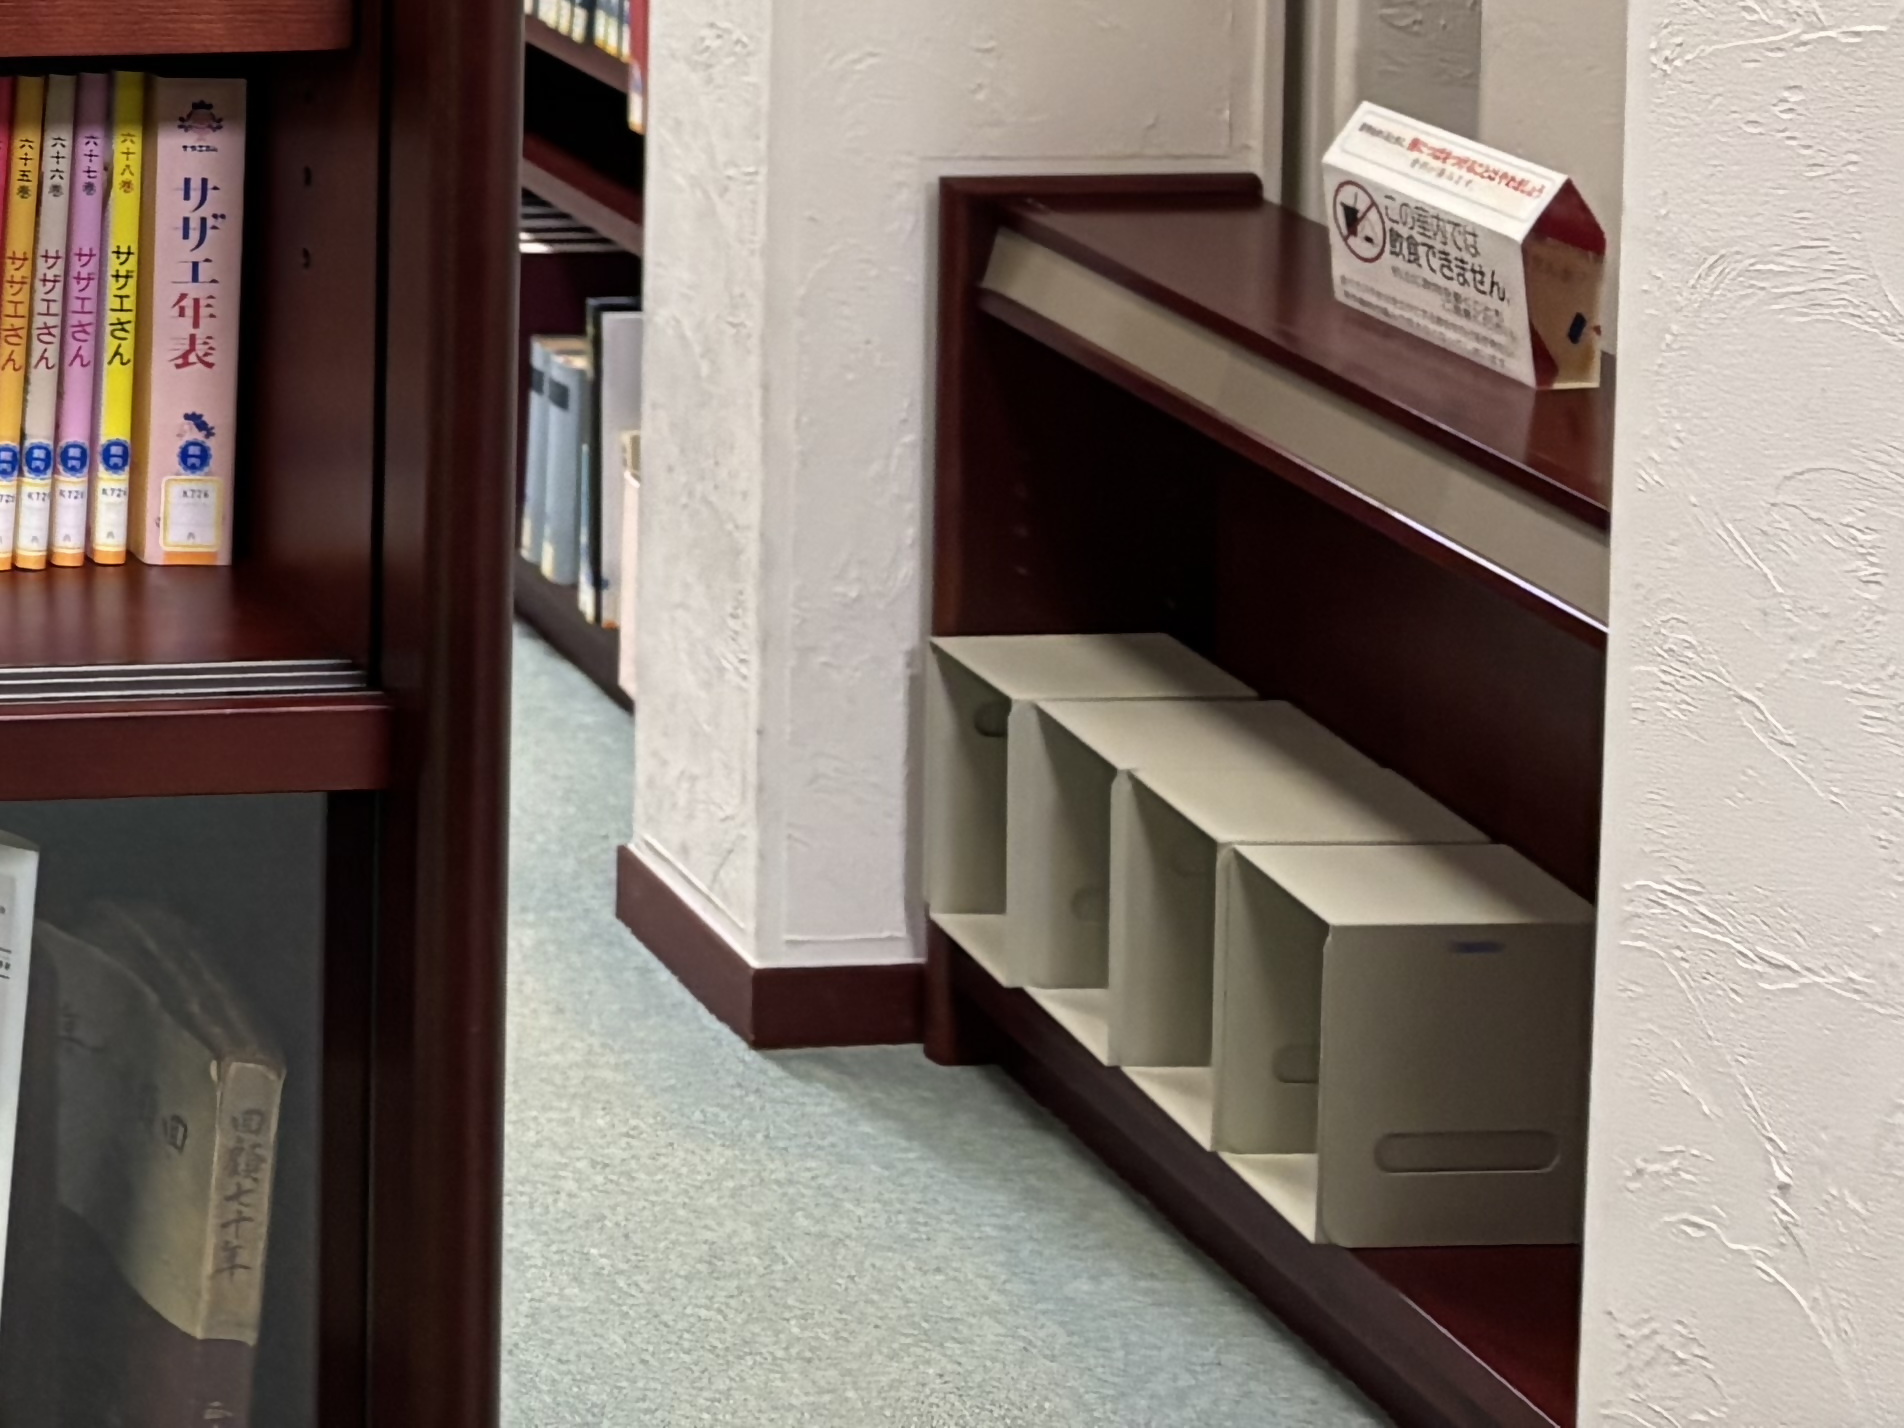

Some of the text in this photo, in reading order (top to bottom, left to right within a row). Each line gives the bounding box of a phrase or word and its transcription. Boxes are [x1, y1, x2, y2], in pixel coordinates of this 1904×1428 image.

[107, 245, 137, 368] サザエさん
[169, 175, 227, 372] サザエ年表
